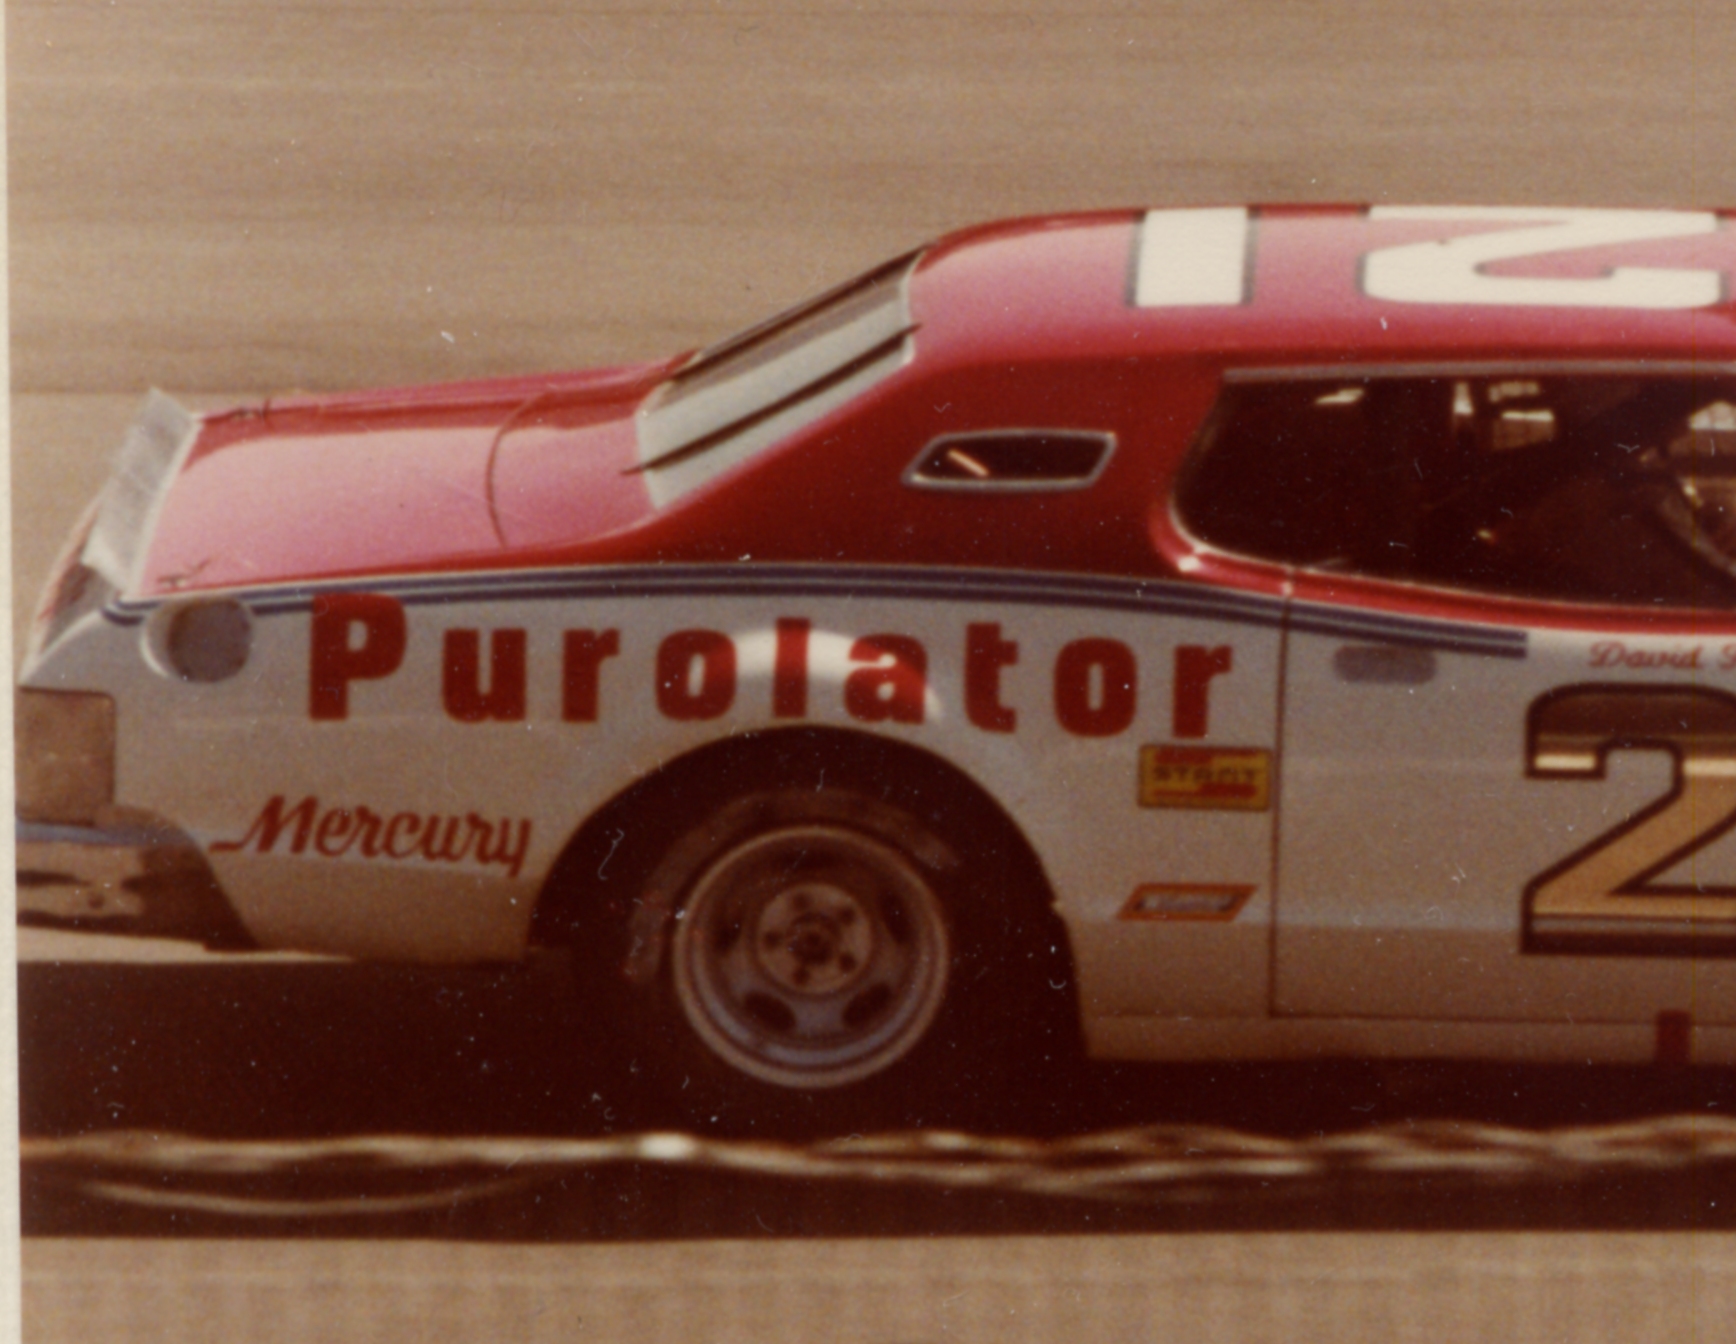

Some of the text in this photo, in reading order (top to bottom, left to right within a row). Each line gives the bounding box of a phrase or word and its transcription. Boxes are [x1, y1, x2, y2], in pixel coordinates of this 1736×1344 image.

[307, 591, 1232, 739] Purolator
[1588, 640, 1704, 669] David
[208, 794, 532, 878] Mercury
